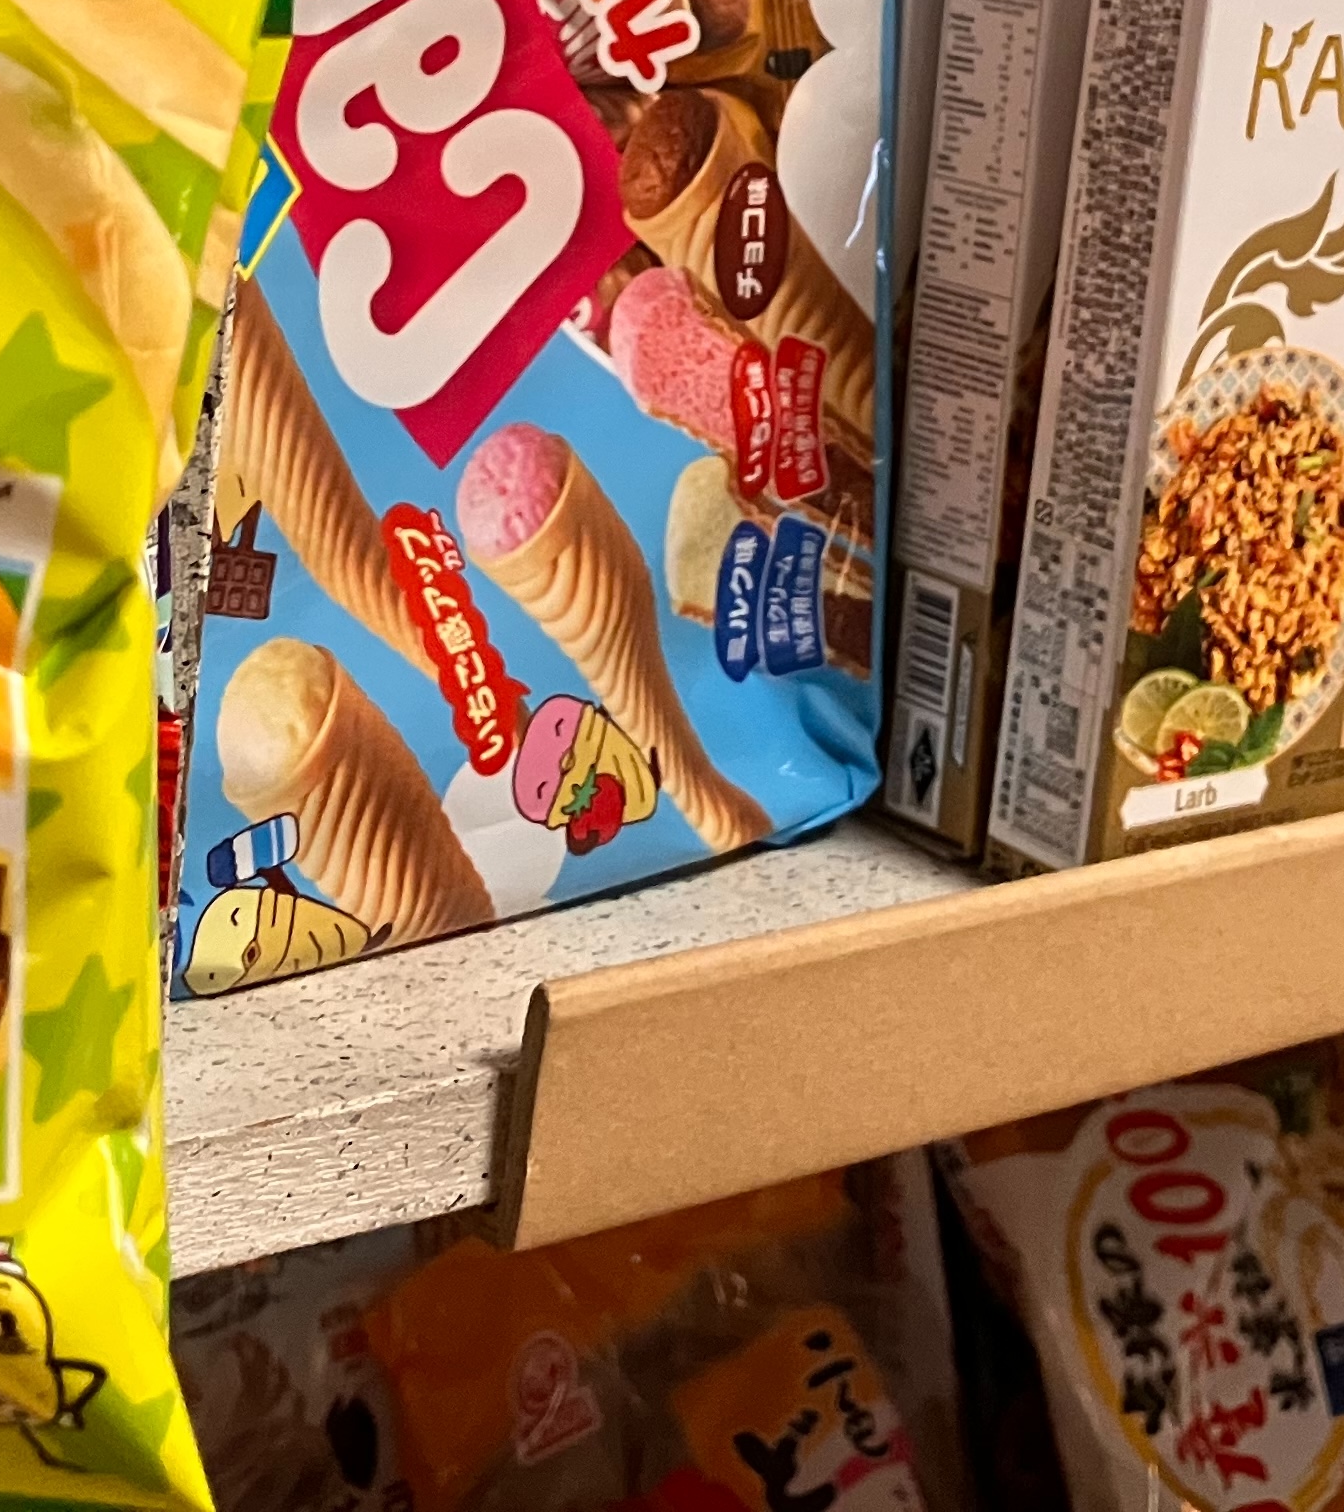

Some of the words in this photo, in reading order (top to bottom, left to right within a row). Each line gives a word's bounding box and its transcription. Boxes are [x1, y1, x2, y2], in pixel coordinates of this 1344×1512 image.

[735, 177, 771, 300] チョコ味
[743, 359, 772, 484] いちご味
[725, 535, 759, 662] ミルク味
[1174, 781, 1218, 814] Larb
